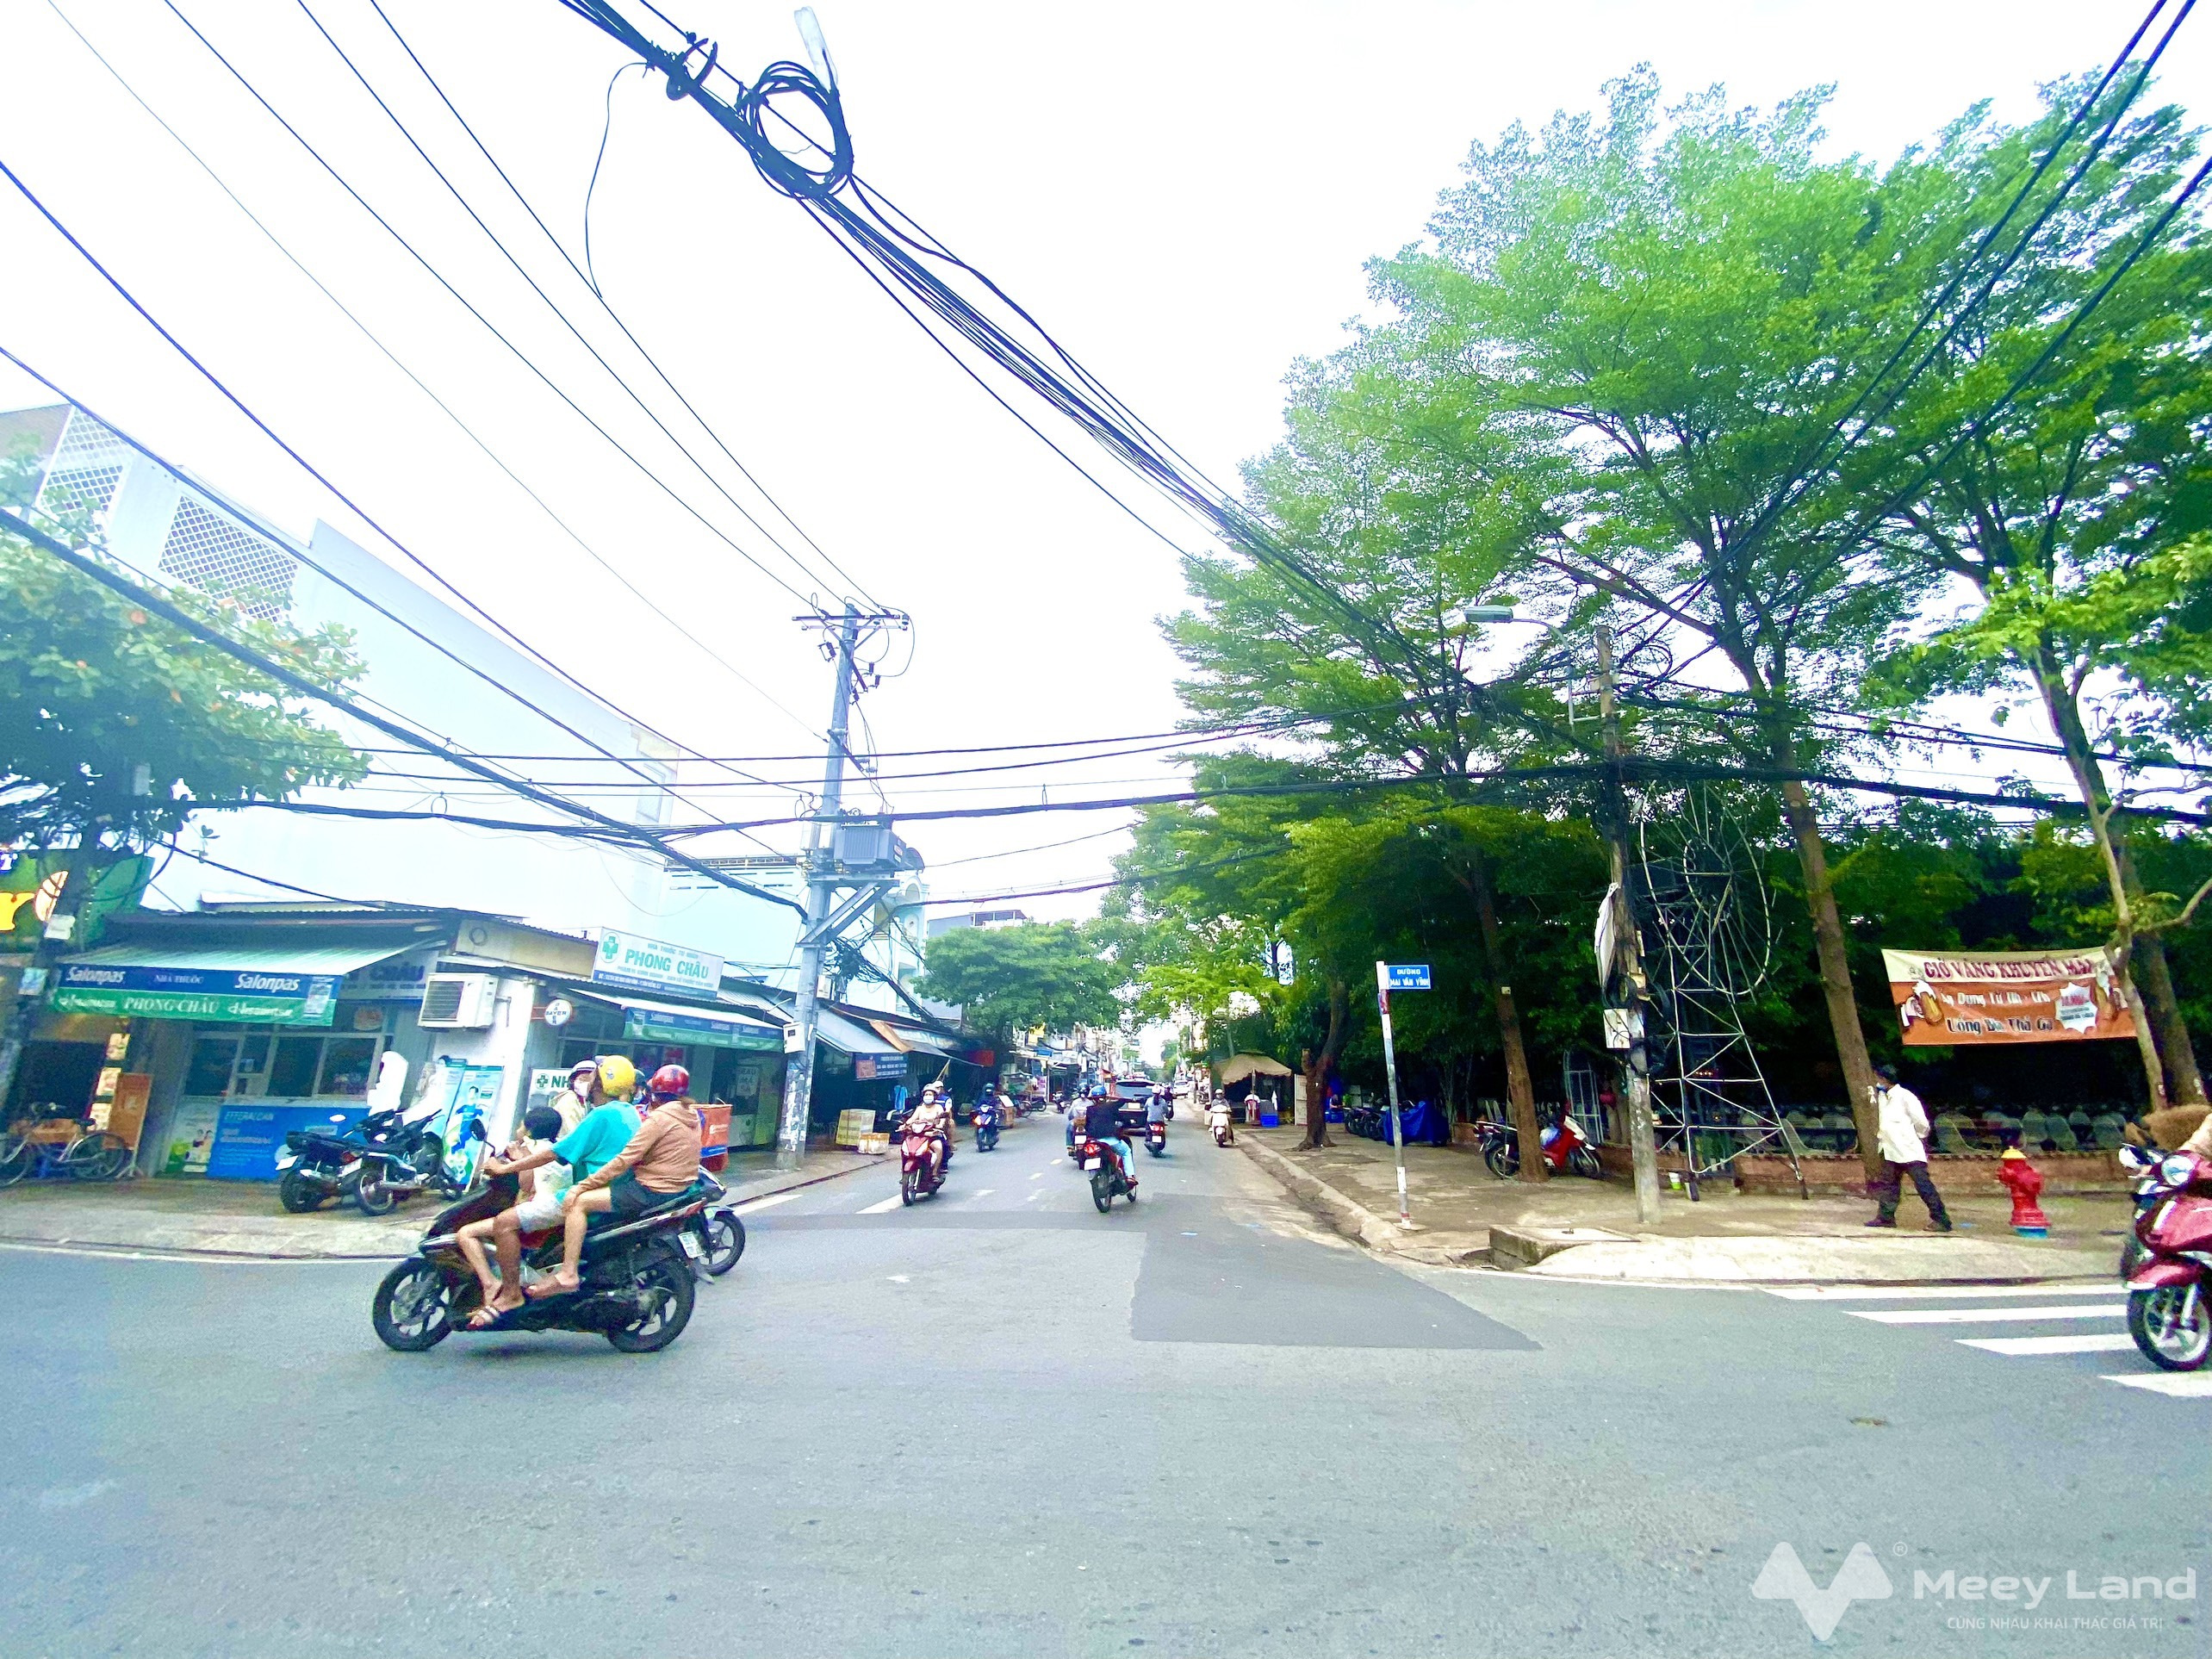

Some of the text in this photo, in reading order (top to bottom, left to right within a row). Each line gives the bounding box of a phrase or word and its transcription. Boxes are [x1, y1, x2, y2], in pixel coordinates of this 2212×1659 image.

[624, 948, 672, 972] PHONG
[677, 960, 709, 979] CHÂU
[65, 966, 126, 985] Salonpas
[234, 972, 301, 994] Salonpas
[124, 997, 175, 1012] PHONG
